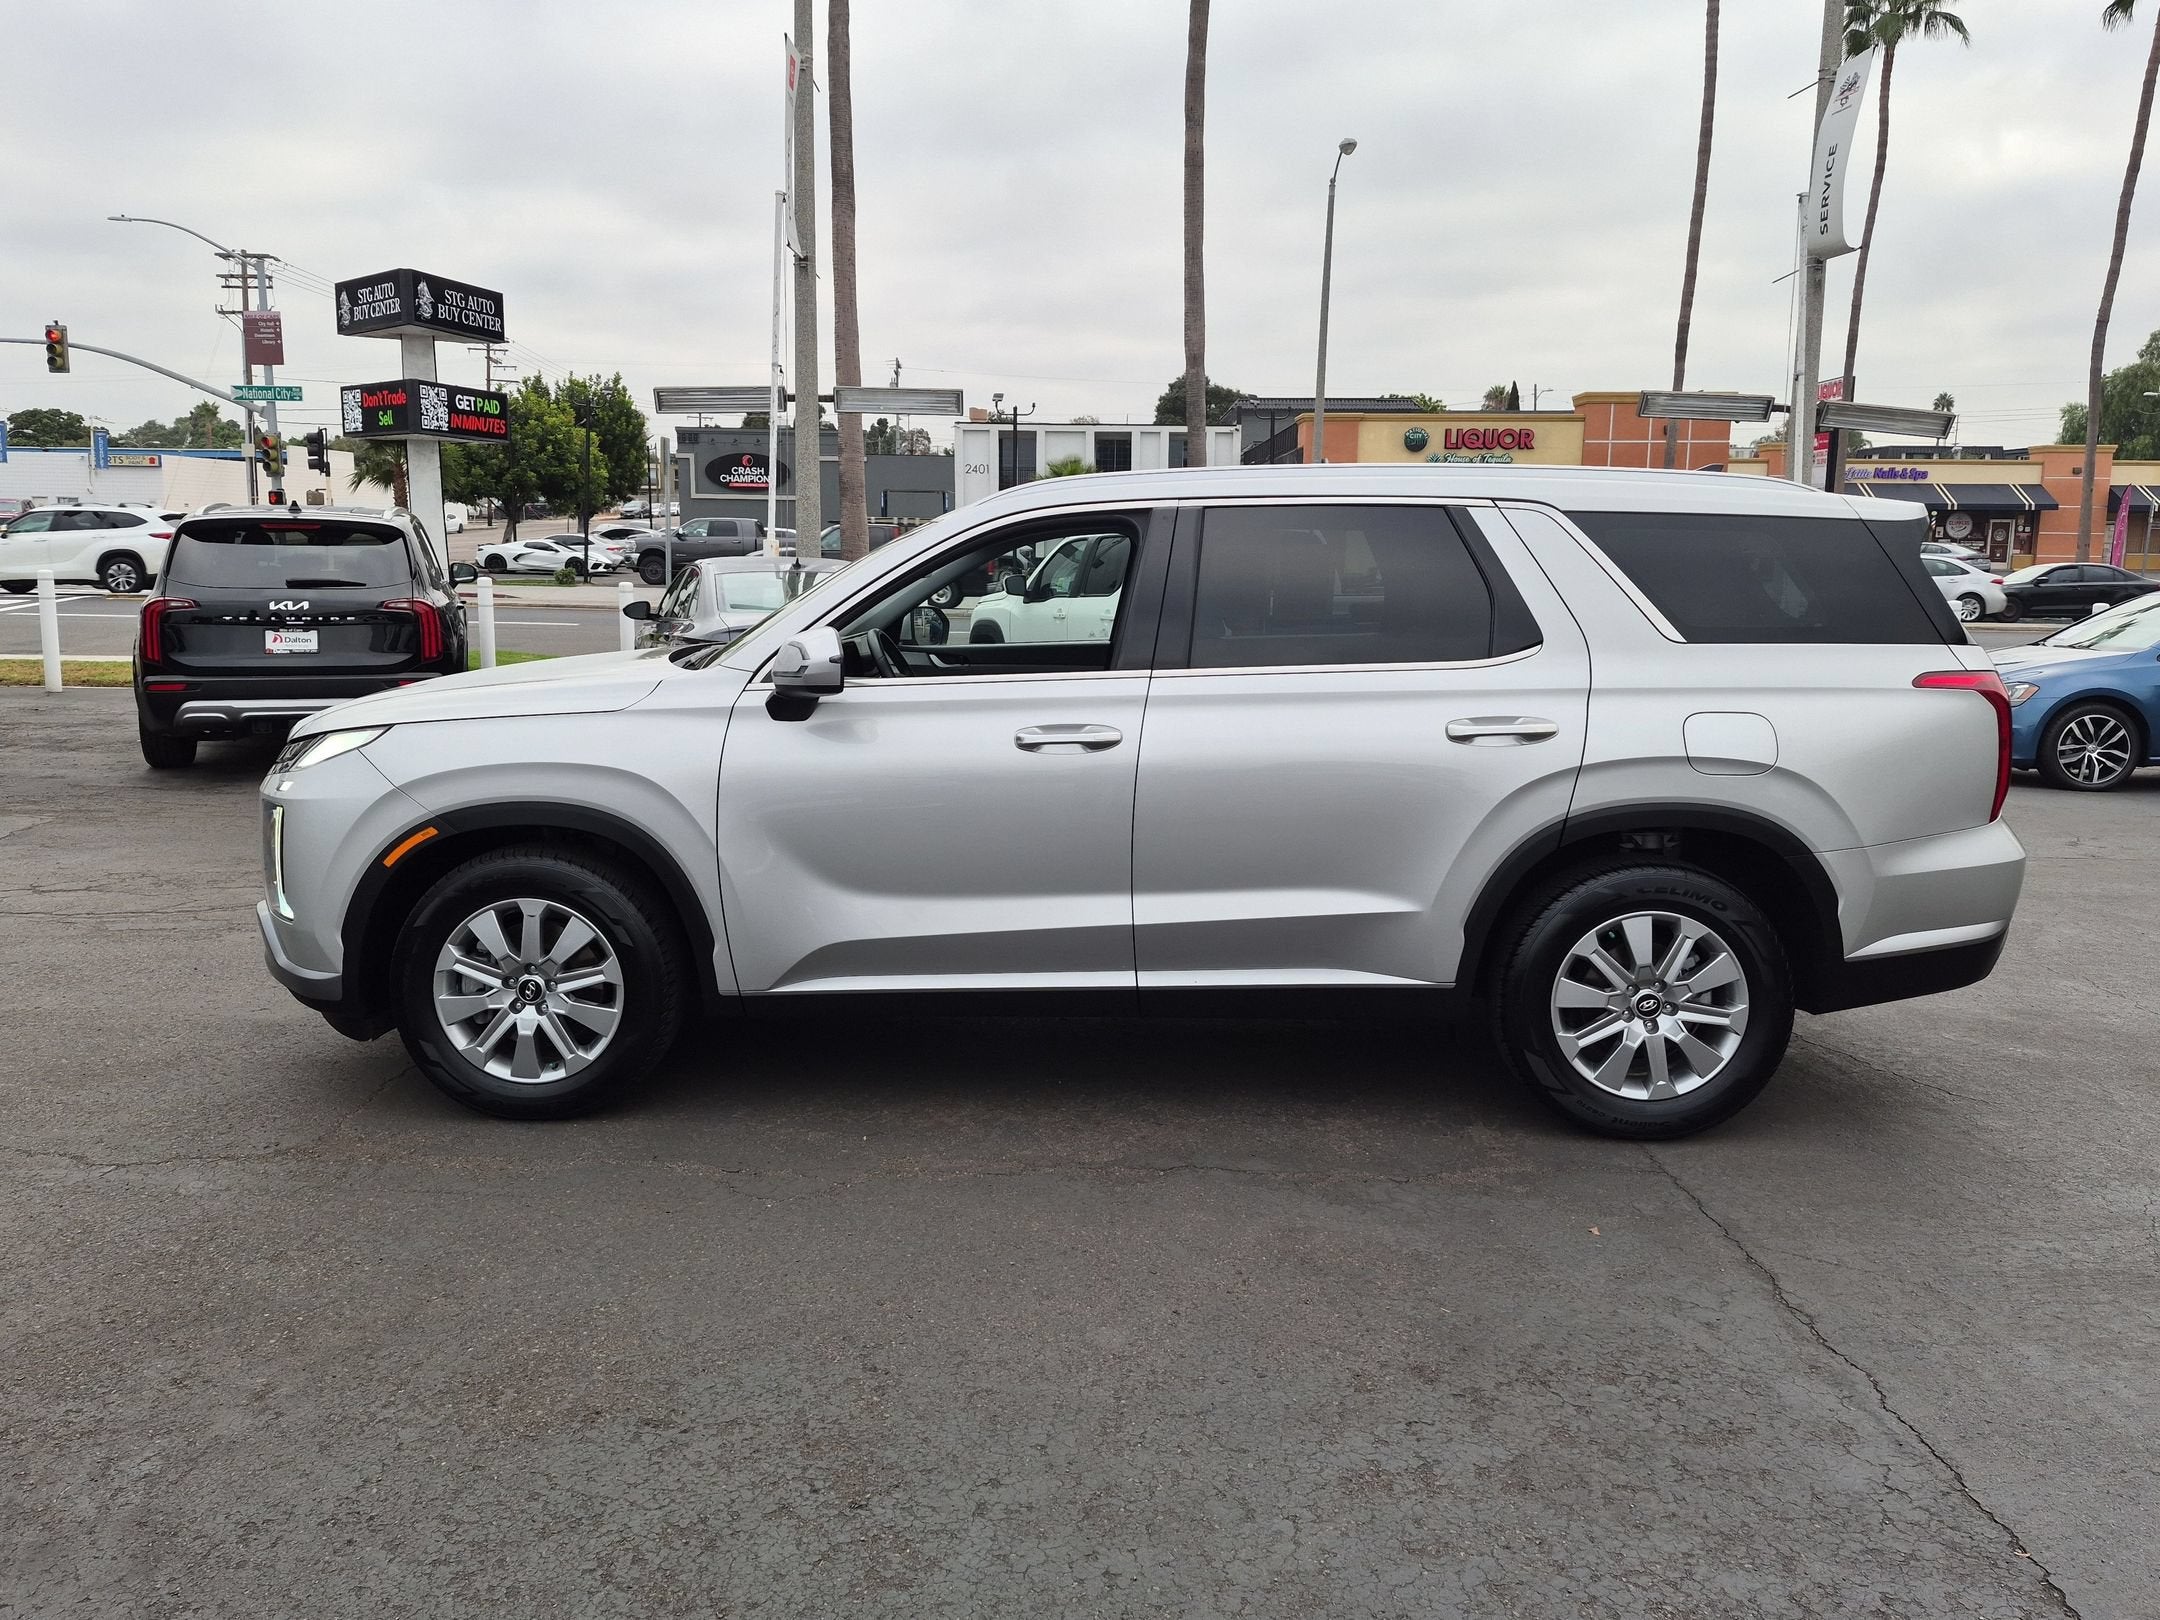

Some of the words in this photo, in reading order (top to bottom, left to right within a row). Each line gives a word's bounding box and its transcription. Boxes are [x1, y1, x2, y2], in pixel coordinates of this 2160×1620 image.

[1819, 143, 1838, 236] SERVICE
[357, 286, 374, 304] STG
[374, 282, 395, 300] AUTO
[444, 289, 466, 308] STG
[467, 295, 495, 315] AUTO
[353, 304, 370, 321] BUY
[370, 297, 401, 318] CENTER
[438, 303, 461, 322] BUY
[462, 309, 502, 332] CENTER
[242, 387, 275, 399] National
[276, 387, 291, 400] City
[362, 391, 384, 408] Don't
[383, 389, 407, 406] Trade
[455, 394, 475, 411] GET
[476, 397, 501, 415] PAID
[378, 410, 393, 426] Sell
[450, 414, 462, 428] IN
[462, 415, 506, 434] MINUTES
[1444, 428, 1535, 449] LIQUOR
[1443, 452, 1470, 464] House
[1472, 452, 1480, 464] of
[1483, 452, 1513, 464] Tequila
[731, 466, 765, 475] CRASH
[965, 463, 990, 474] 2401
[1873, 467, 1900, 480] Nails
[1900, 467, 1909, 480] &
[1909, 467, 1929, 481] Spa
[720, 474, 770, 483] CHAMPION
[269, 601, 309, 610] KIA
